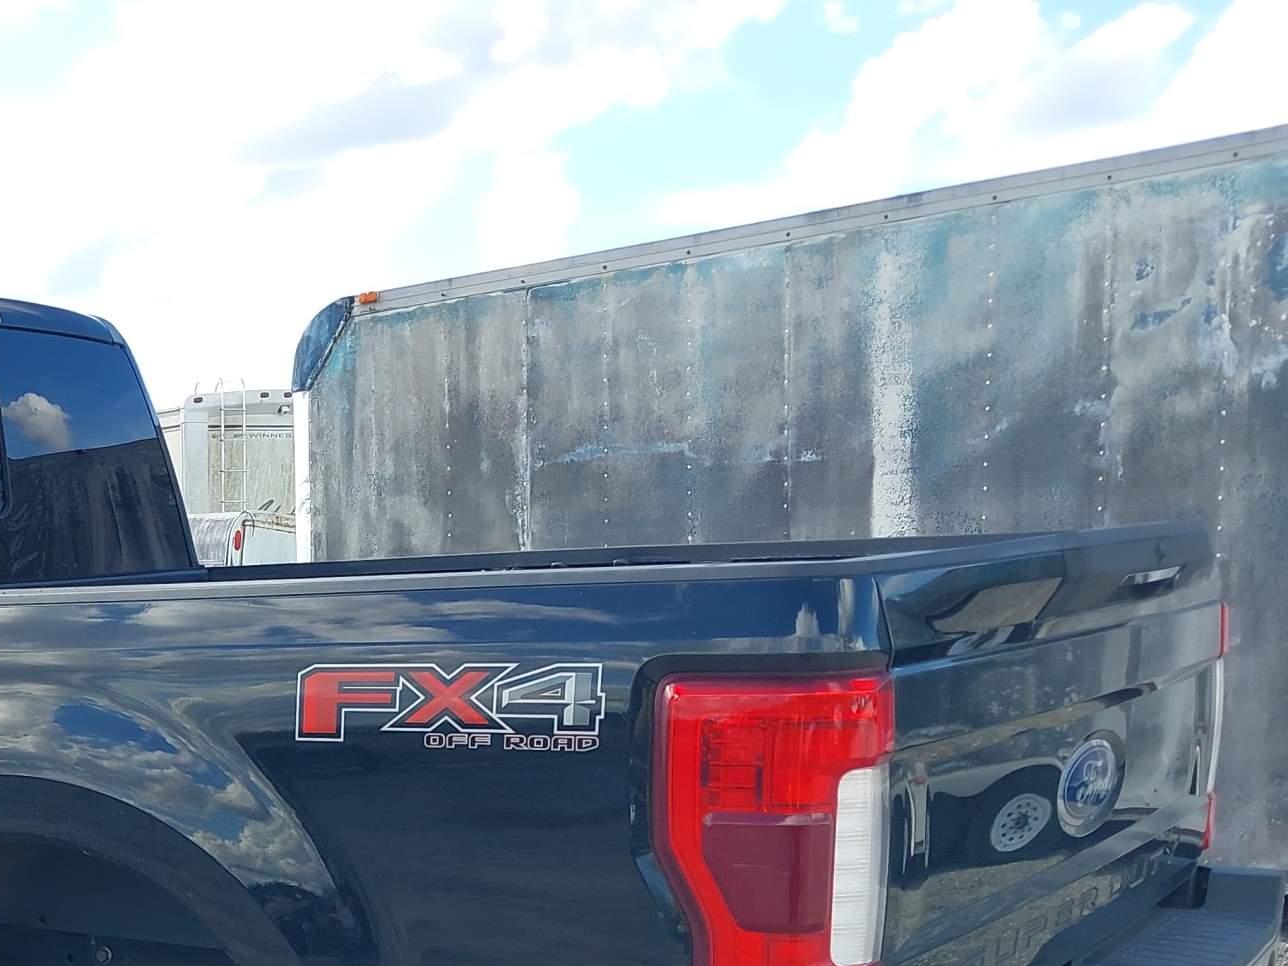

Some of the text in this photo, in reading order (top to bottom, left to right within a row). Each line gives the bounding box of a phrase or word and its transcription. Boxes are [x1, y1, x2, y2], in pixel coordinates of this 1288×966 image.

[296, 662, 605, 742] FX4
[424, 733, 599, 751] OFF ROAD
[1077, 758, 1113, 804] Ford
